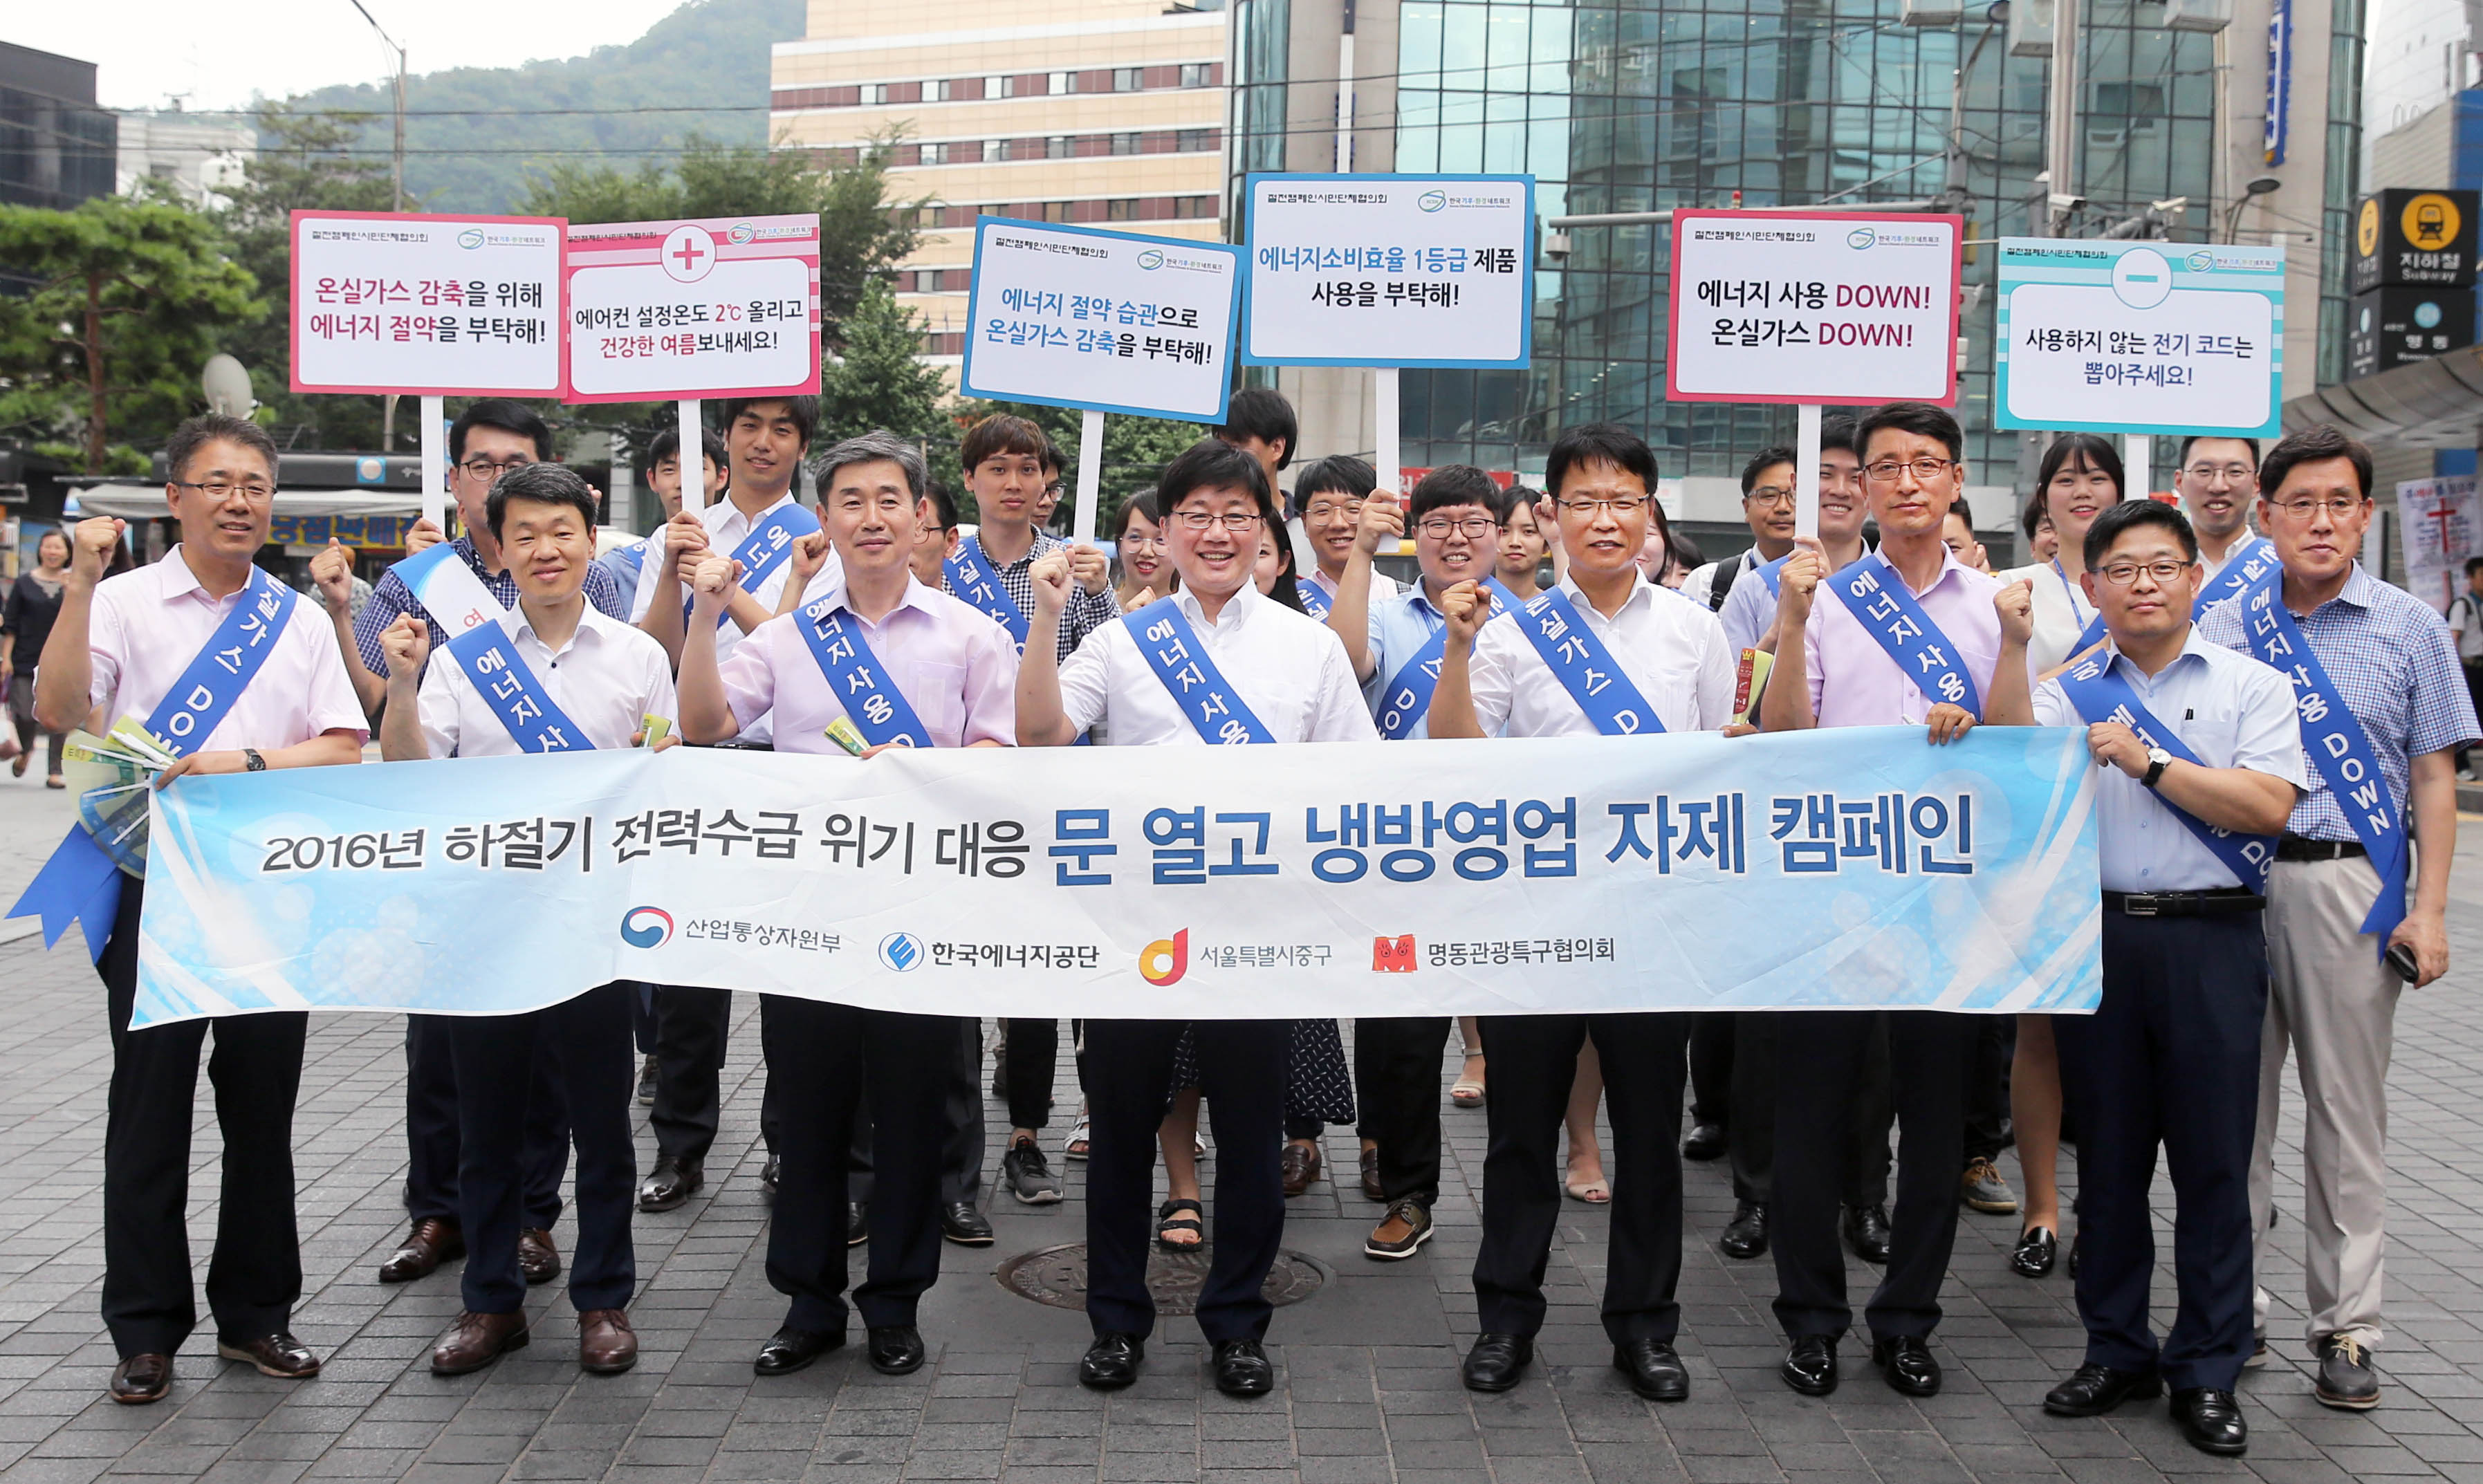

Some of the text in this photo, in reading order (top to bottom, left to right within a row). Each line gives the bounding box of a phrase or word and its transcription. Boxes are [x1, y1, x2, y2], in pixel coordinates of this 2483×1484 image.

[1258, 245, 1517, 275] 에너지소비효율 1등급 제품
[2400, 252, 2460, 269] 지하철
[2402, 269, 2457, 282] Subway
[315, 277, 543, 308] 온실가스 감축을 위해
[1310, 281, 1459, 308] 사용을 부탁해!
[1697, 279, 1931, 310] 에너지 사용 DOWN!
[575, 306, 630, 331] 에어컨
[636, 304, 709, 328] 설정온도
[747, 299, 804, 322] 올리고
[1001, 287, 1199, 330] 에너지 절약 습관으로
[310, 315, 546, 344] 에너지 절약을 부탁해!
[986, 318, 1212, 367] 온실가스 감축을 부탁해!
[1712, 318, 1913, 347] 온실가스 DOWN!
[2026, 326, 2253, 360] 사용하지 않는 전기 코드는
[600, 336, 655, 359] 건강한
[2084, 361, 2193, 388] 뽑아주세요!
[1524, 593, 1612, 697] 온실가스
[1849, 570, 1966, 702] 에너지 사용
[1146, 618, 1208, 694] 에너지
[477, 647, 543, 727] 에너지
[847, 665, 894, 725] 사용
[2249, 585, 2292, 662] 에너지
[2323, 731, 2391, 837] DOWN
[261, 792, 1973, 886] 2016년 하절기 전력수급 위기 대응 문 열고 냉방영업 자제 캠페인
[685, 918, 840, 952] 산업통상자원부
[931, 942, 1100, 969] 한국에너지공단
[1200, 945, 1333, 968] 서울특별시중구
[1428, 938, 1615, 967] 명동관광특구협의회
